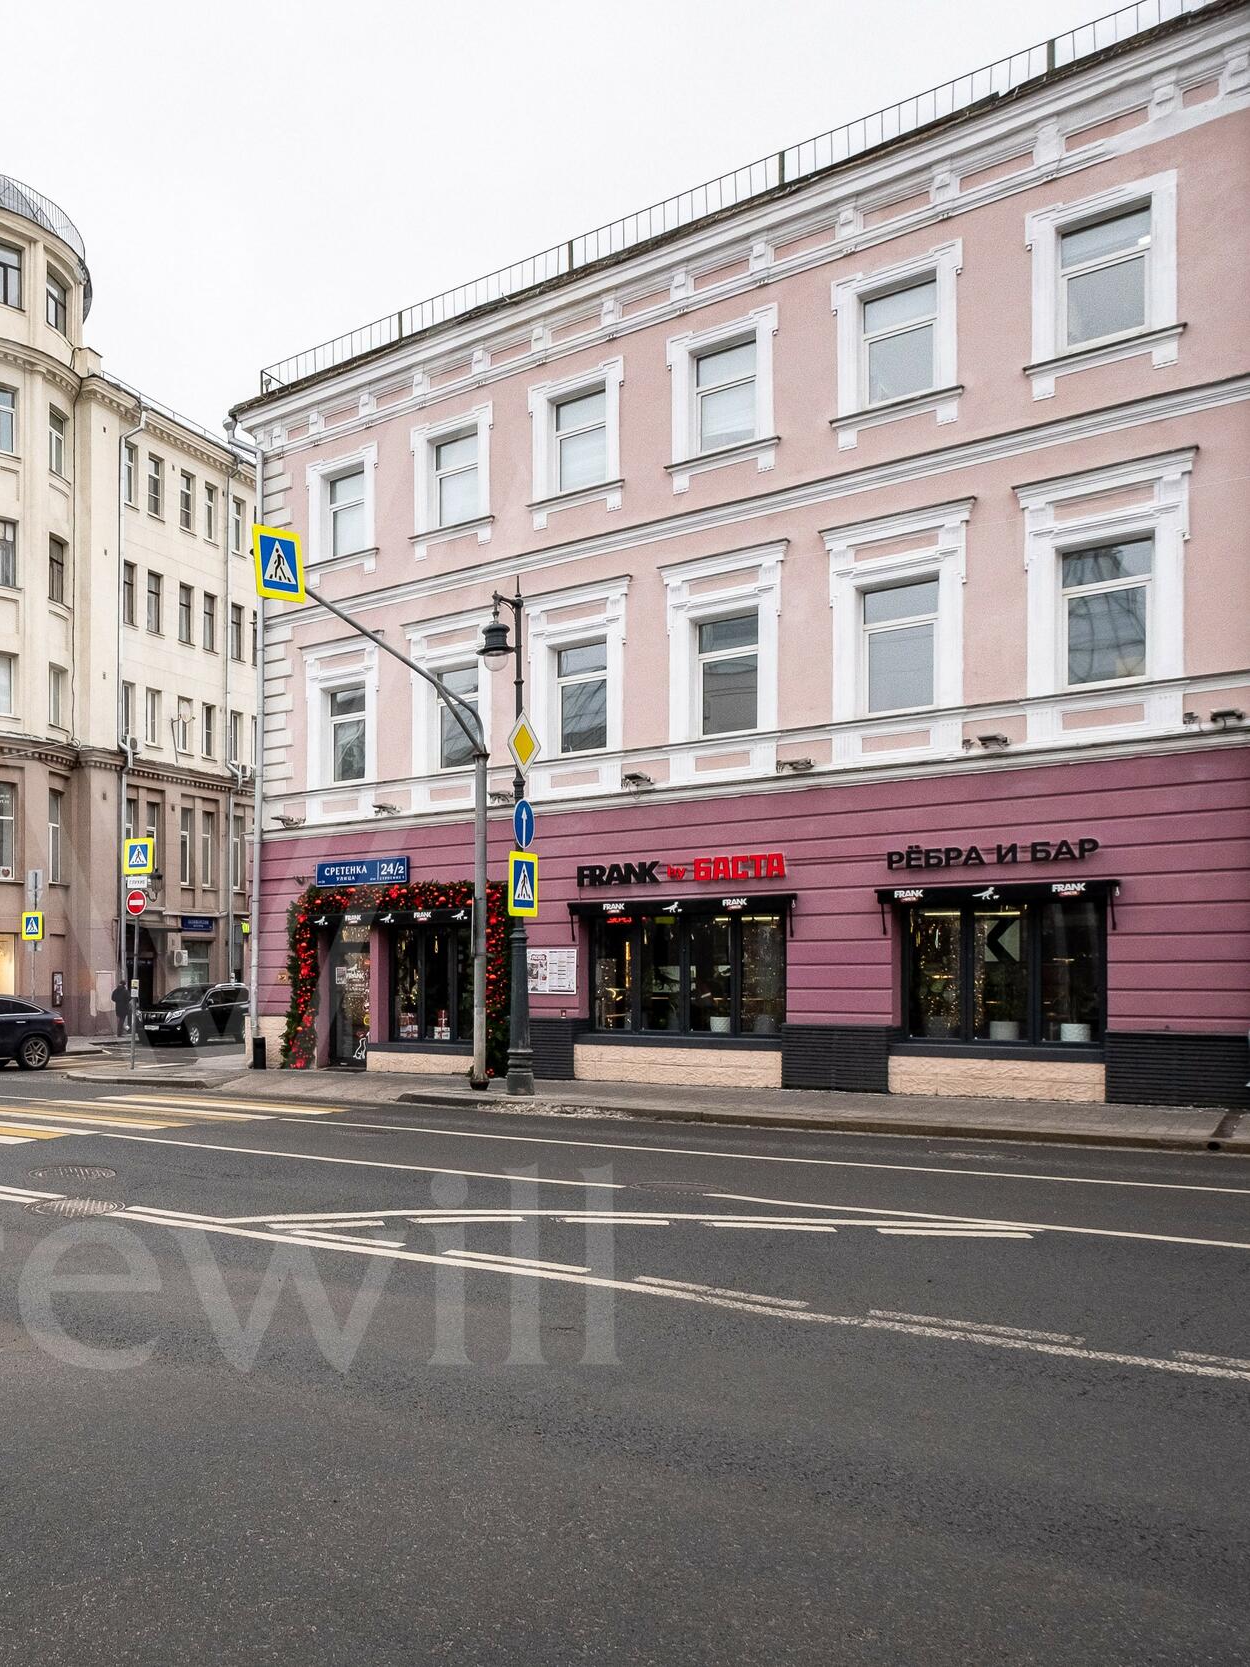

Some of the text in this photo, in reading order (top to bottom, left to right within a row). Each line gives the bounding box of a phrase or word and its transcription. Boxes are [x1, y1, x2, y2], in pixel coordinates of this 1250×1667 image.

[886, 838, 1099, 870] РЁБРА И БАР
[324, 862, 404, 876] СРЕТЕНКА 24/2
[577, 852, 786, 888] FRANK by БАСТА
[1052, 882, 1086, 893] FRANK
[894, 889, 924, 899] FRANK
[602, 902, 625, 910] FRANK
[722, 897, 748, 907] FRANK
[345, 914, 362, 922] FRANK
[413, 911, 432, 919] FRANK
